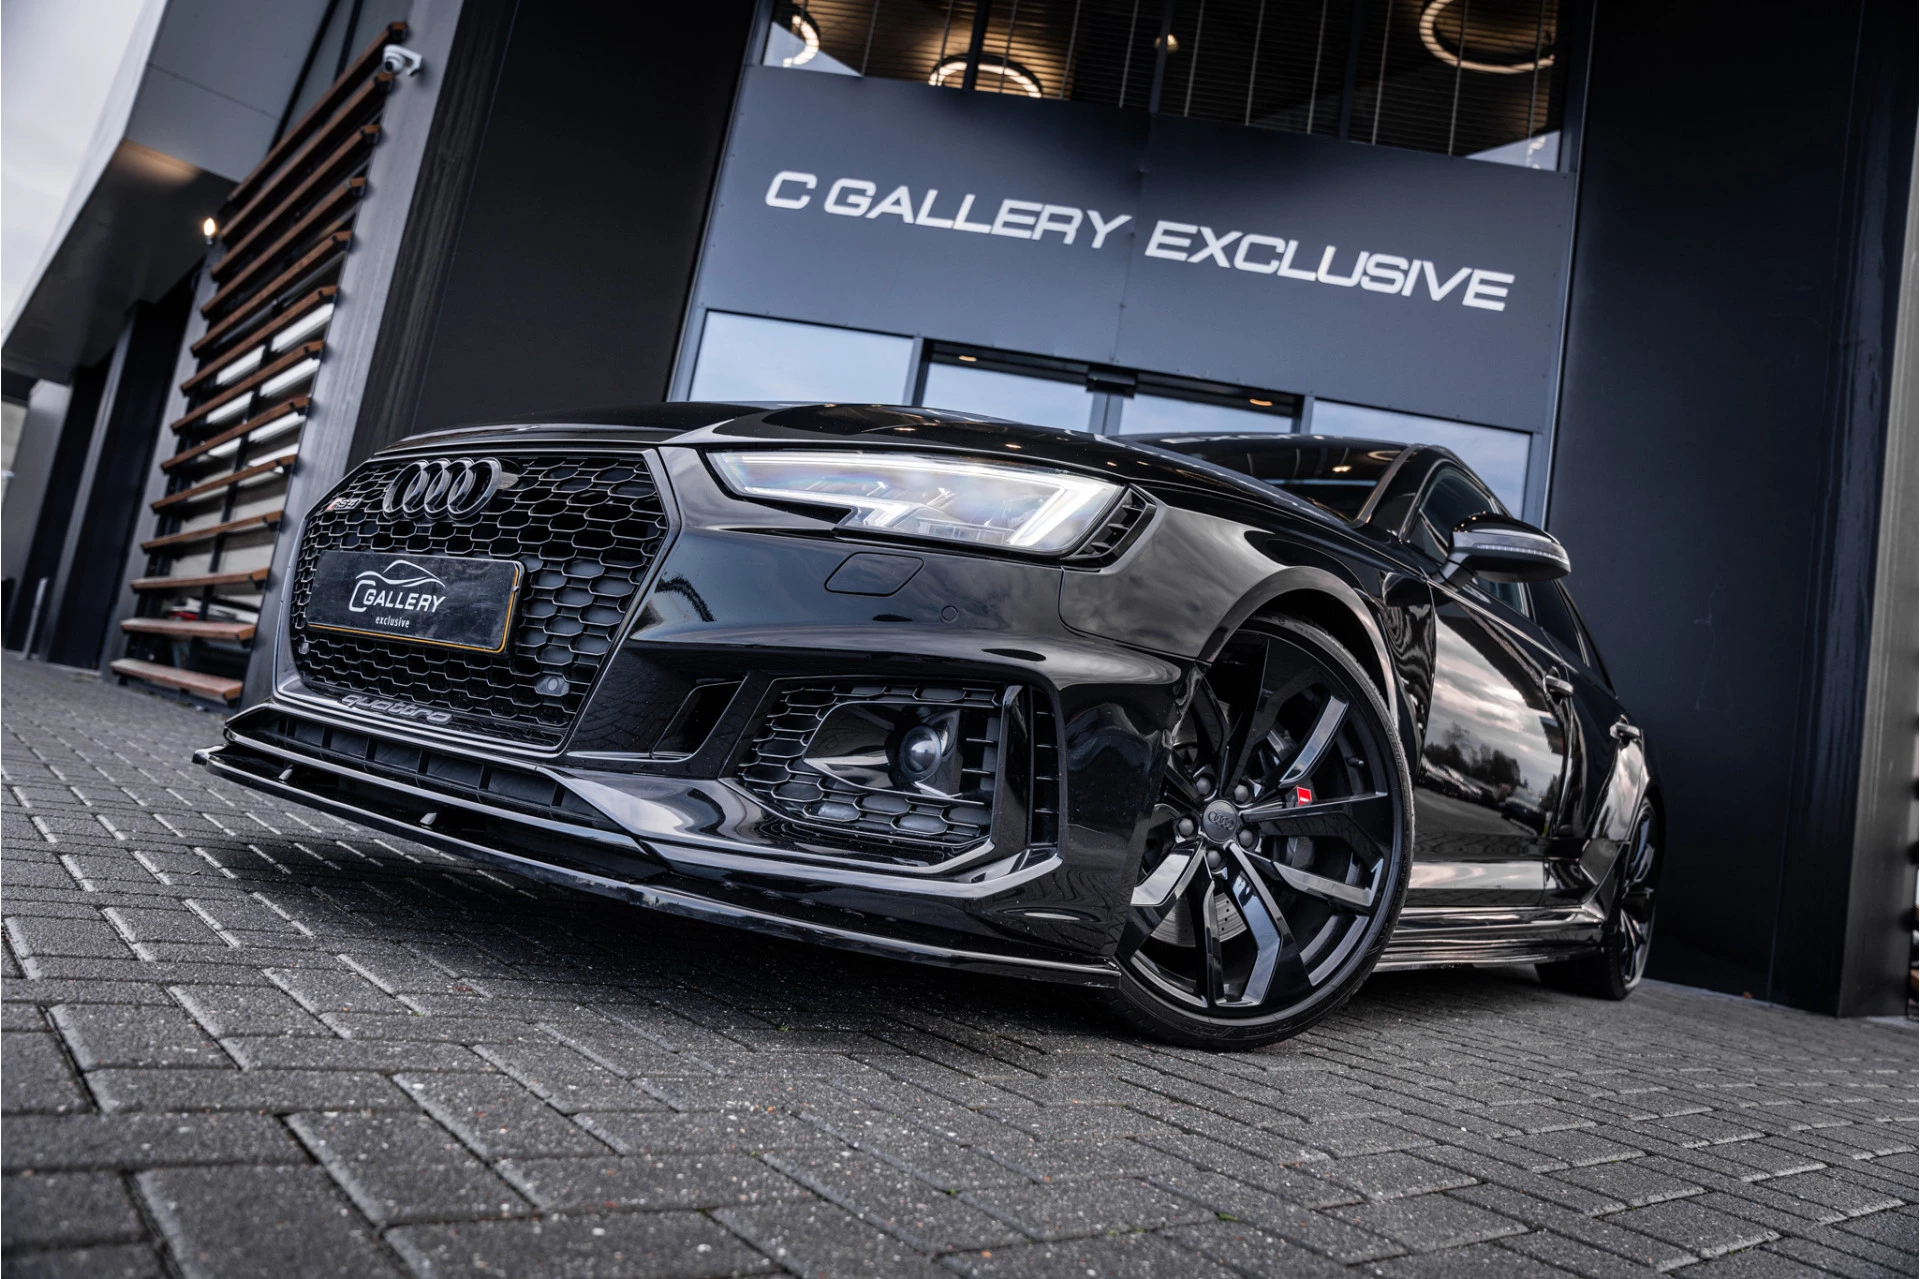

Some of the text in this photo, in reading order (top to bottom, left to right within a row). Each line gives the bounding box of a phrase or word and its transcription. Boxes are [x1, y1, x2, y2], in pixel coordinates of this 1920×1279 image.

[765, 170, 1515, 312] C GALLERY EXCLUSIVE
[375, 614, 410, 628] exclusive
[341, 694, 452, 725] quattro
